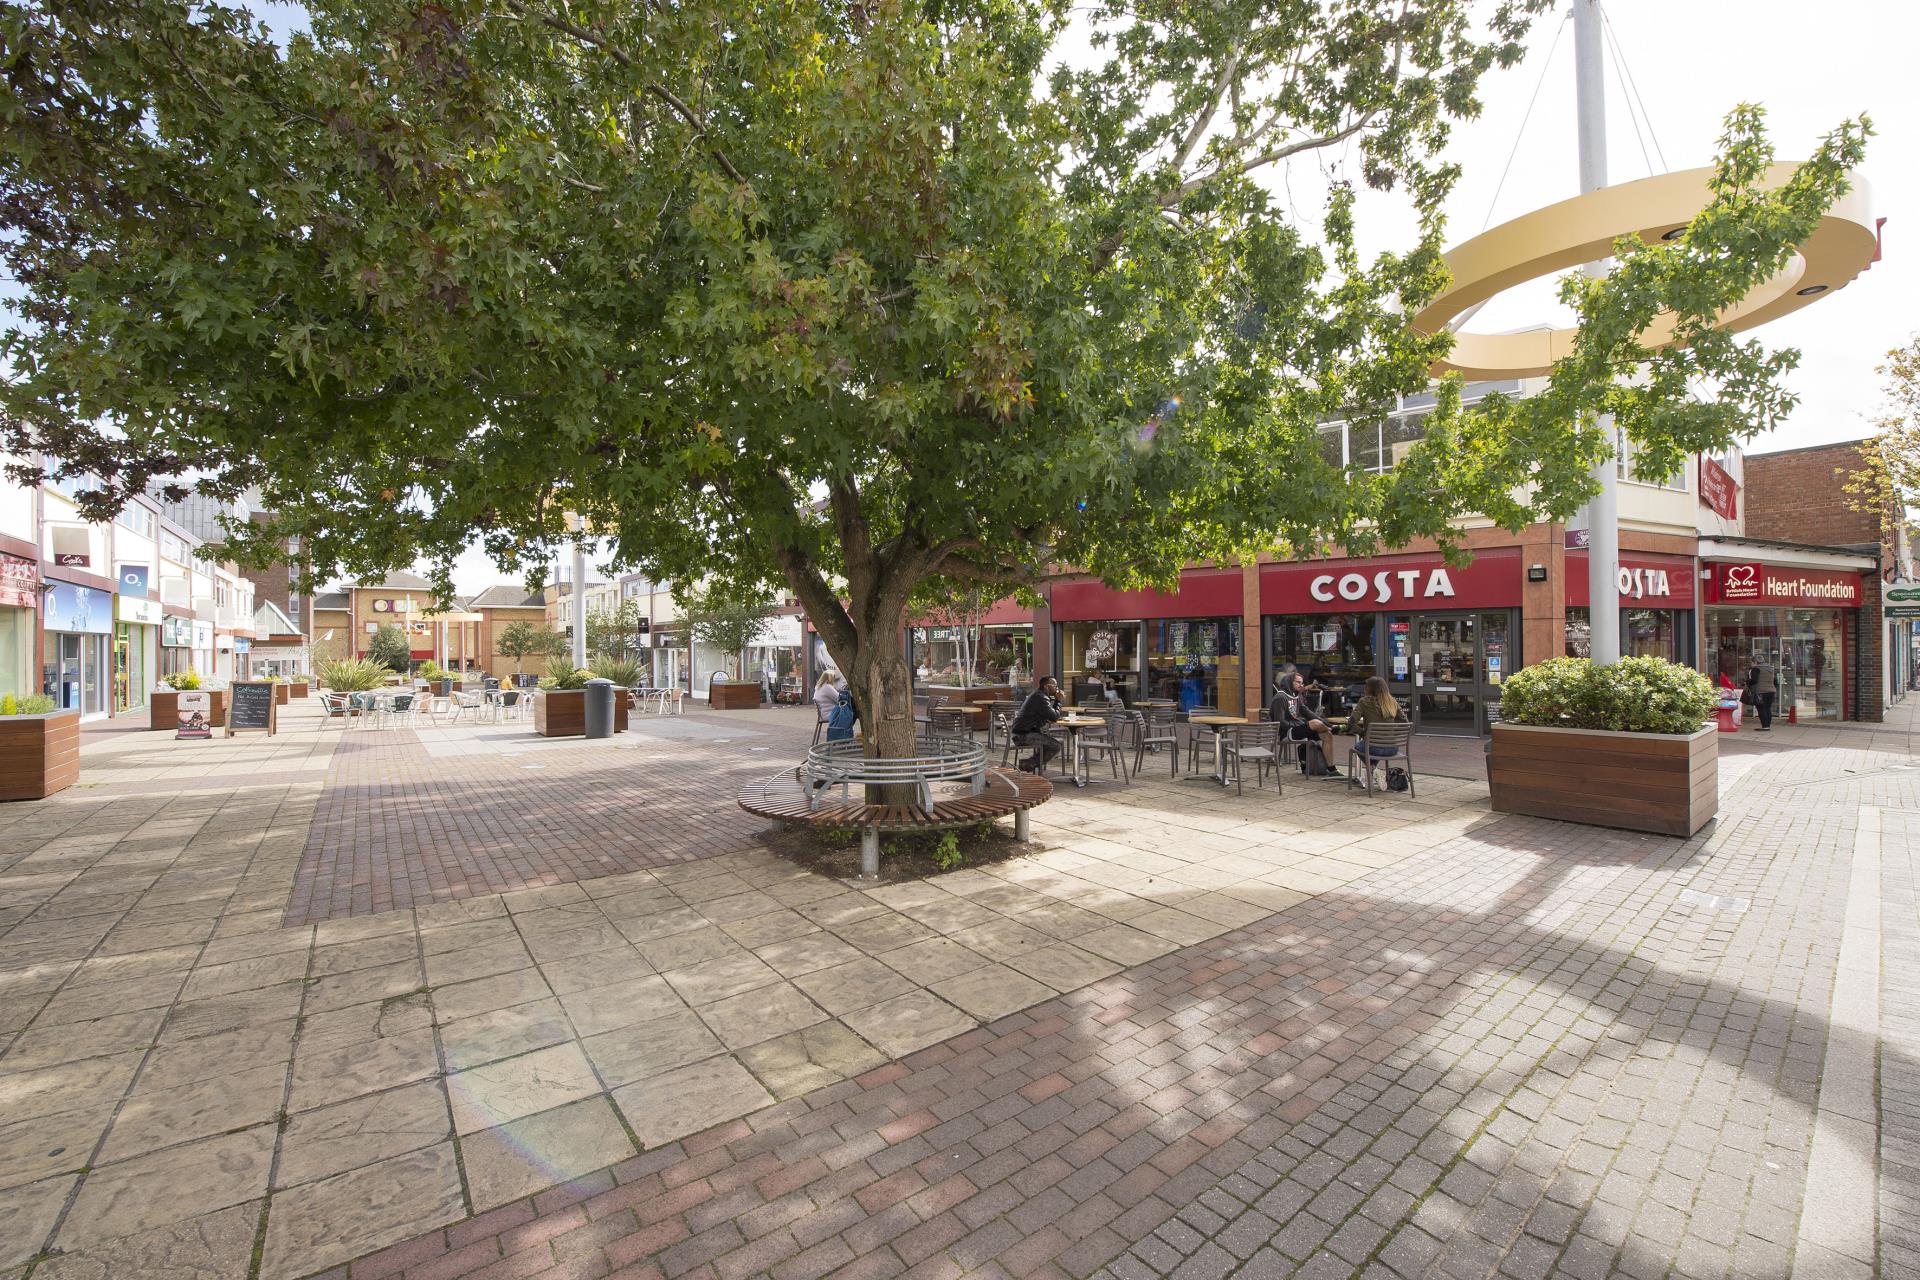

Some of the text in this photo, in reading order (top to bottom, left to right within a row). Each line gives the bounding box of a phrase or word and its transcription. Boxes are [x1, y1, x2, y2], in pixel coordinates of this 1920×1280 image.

[1310, 568, 1456, 604] COSTA
[1618, 566, 1670, 600] OSTA
[1767, 577, 1798, 597] Heart
[1799, 578, 1855, 599] Foundation
